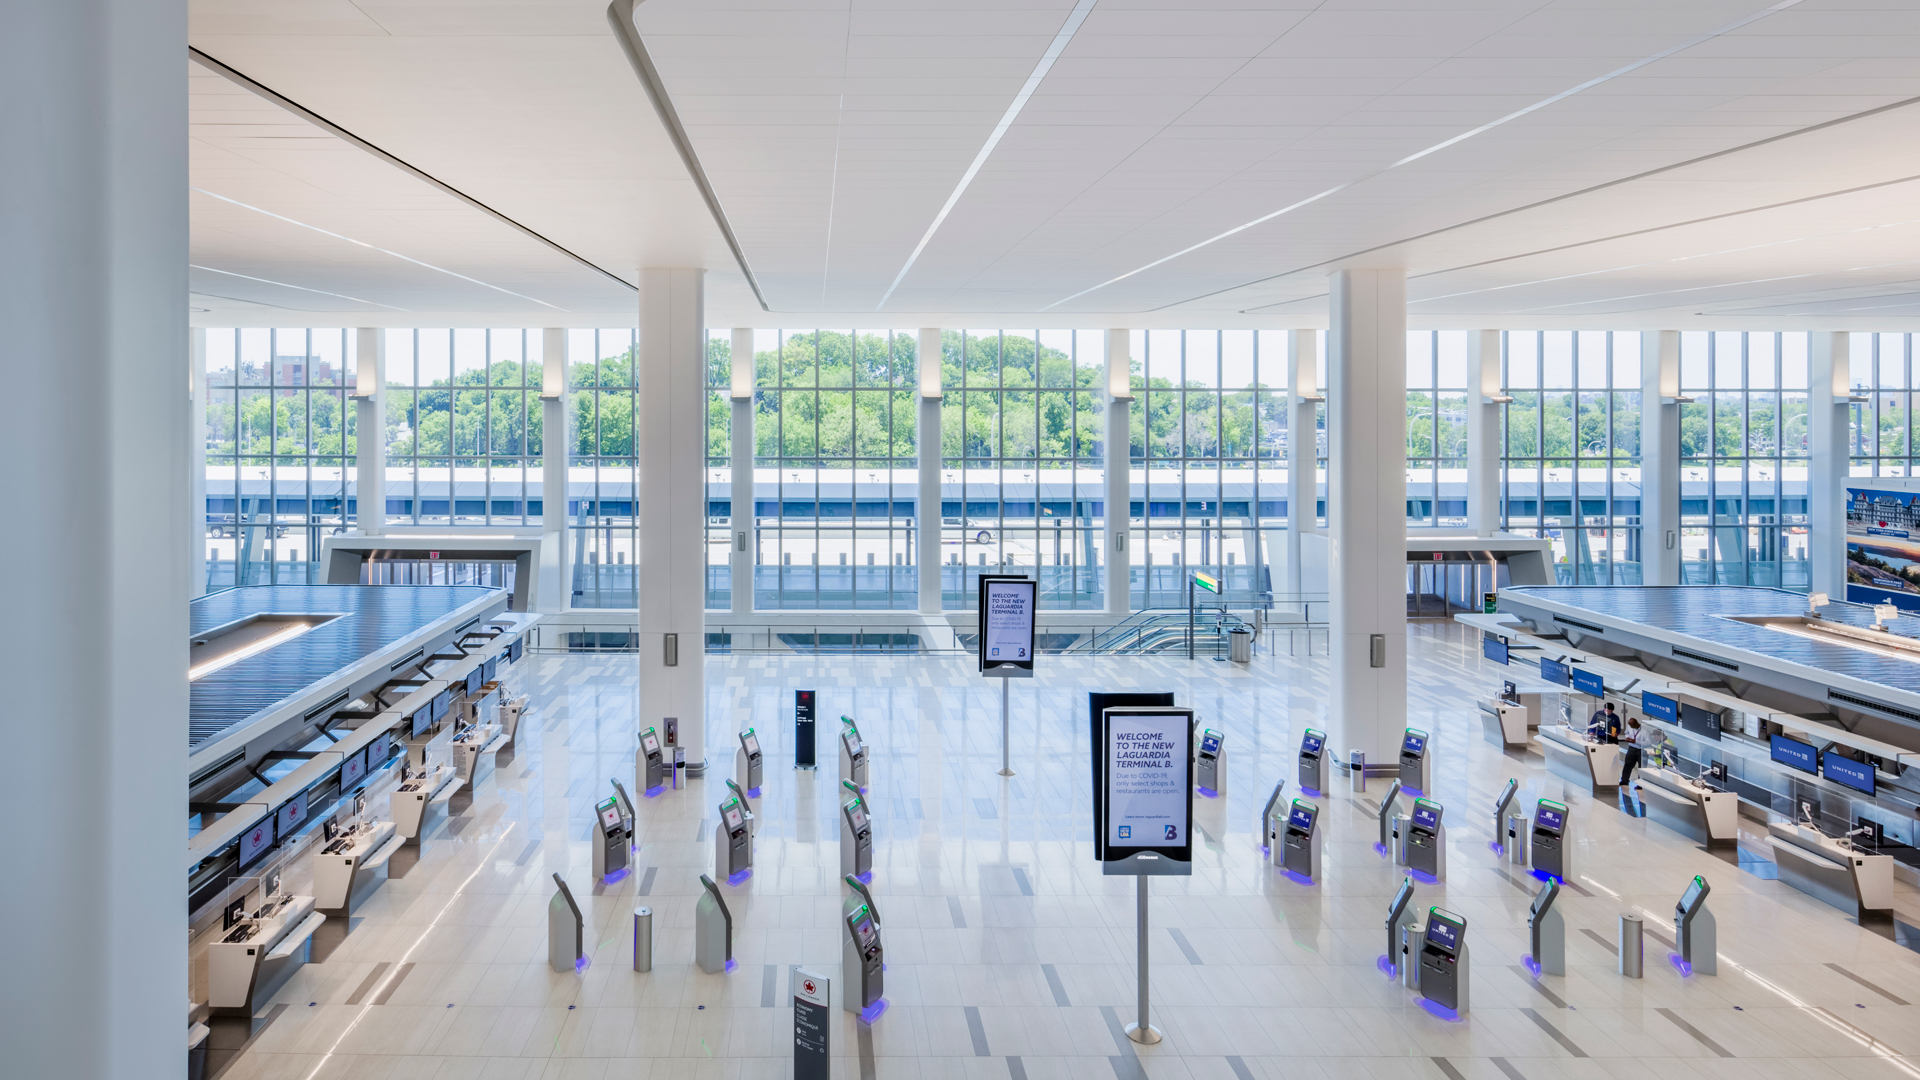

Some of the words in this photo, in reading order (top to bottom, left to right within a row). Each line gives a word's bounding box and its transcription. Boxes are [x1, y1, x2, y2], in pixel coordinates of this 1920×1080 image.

[582, 501, 589, 510] H
[1648, 702, 1665, 711] UNITED
[1116, 732, 1163, 741] WELCOME
[1778, 747, 1801, 758] UNITED
[1832, 765, 1857, 777] UNITED
[1164, 825, 1177, 840] B
